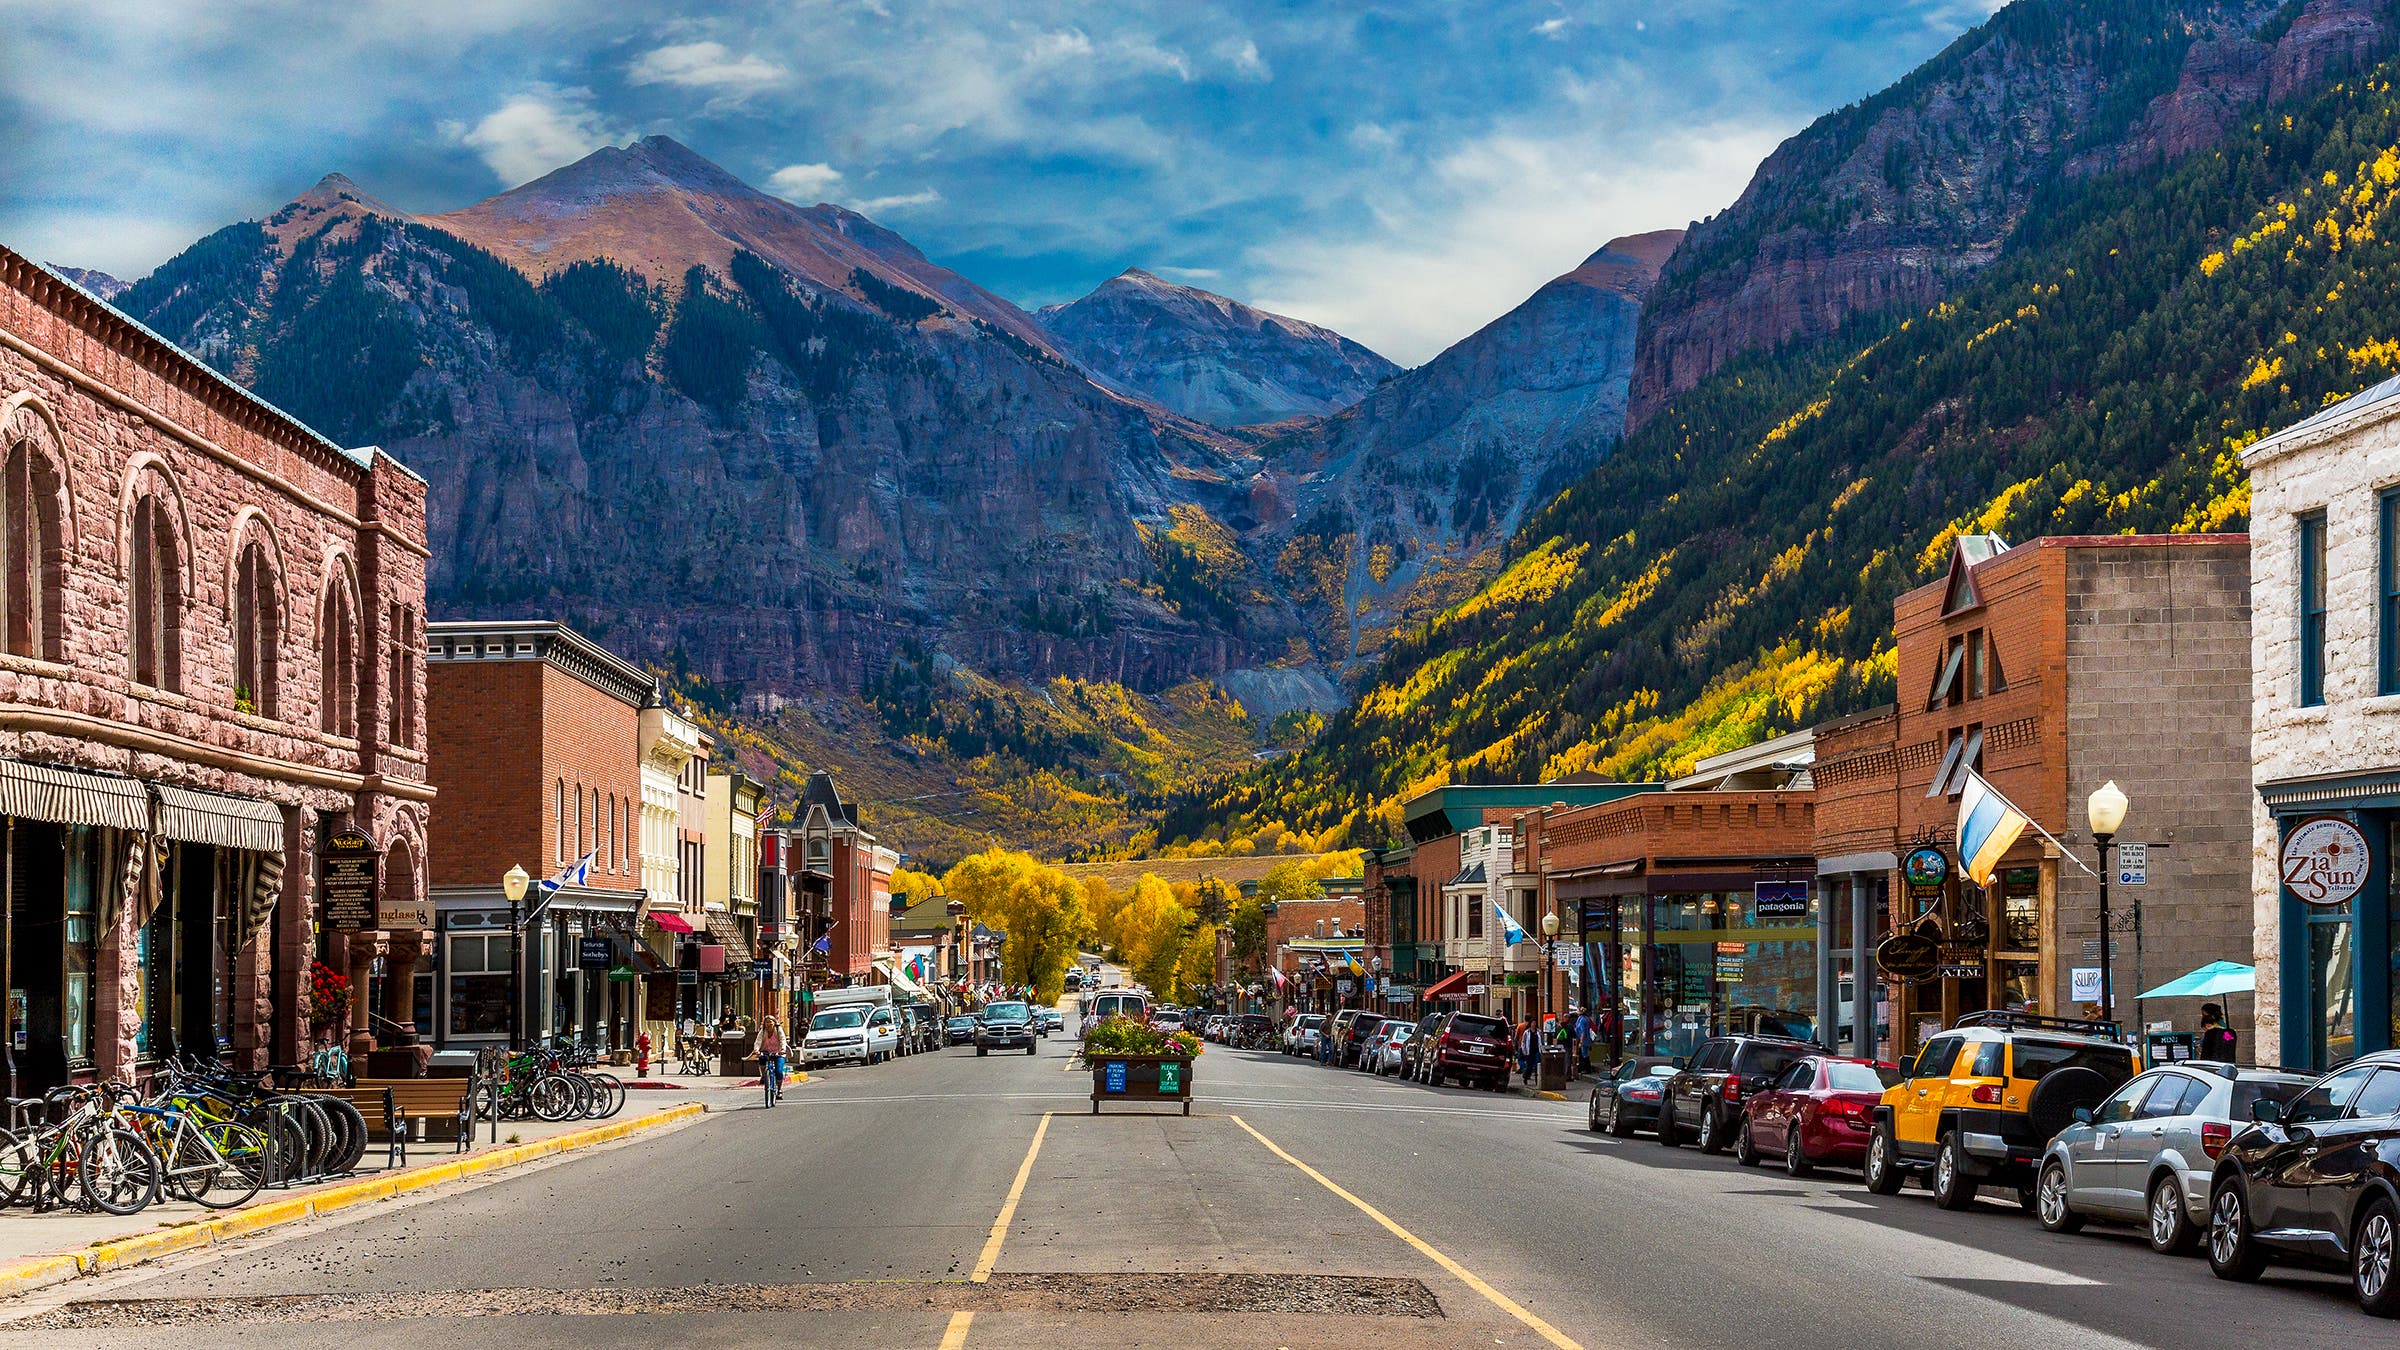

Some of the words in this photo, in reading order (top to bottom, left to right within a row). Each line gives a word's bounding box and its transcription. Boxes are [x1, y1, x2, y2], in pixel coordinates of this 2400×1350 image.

[2284, 851, 2330, 884] Zia
[2309, 870, 2356, 899] Sun
[1759, 903, 1804, 912] patagonia
[380, 909, 416, 922] nglass
[582, 951, 609, 959] Sotheby's
[1941, 969, 1981, 977] A.T.M.
[2075, 972, 2098, 987] SLURP
